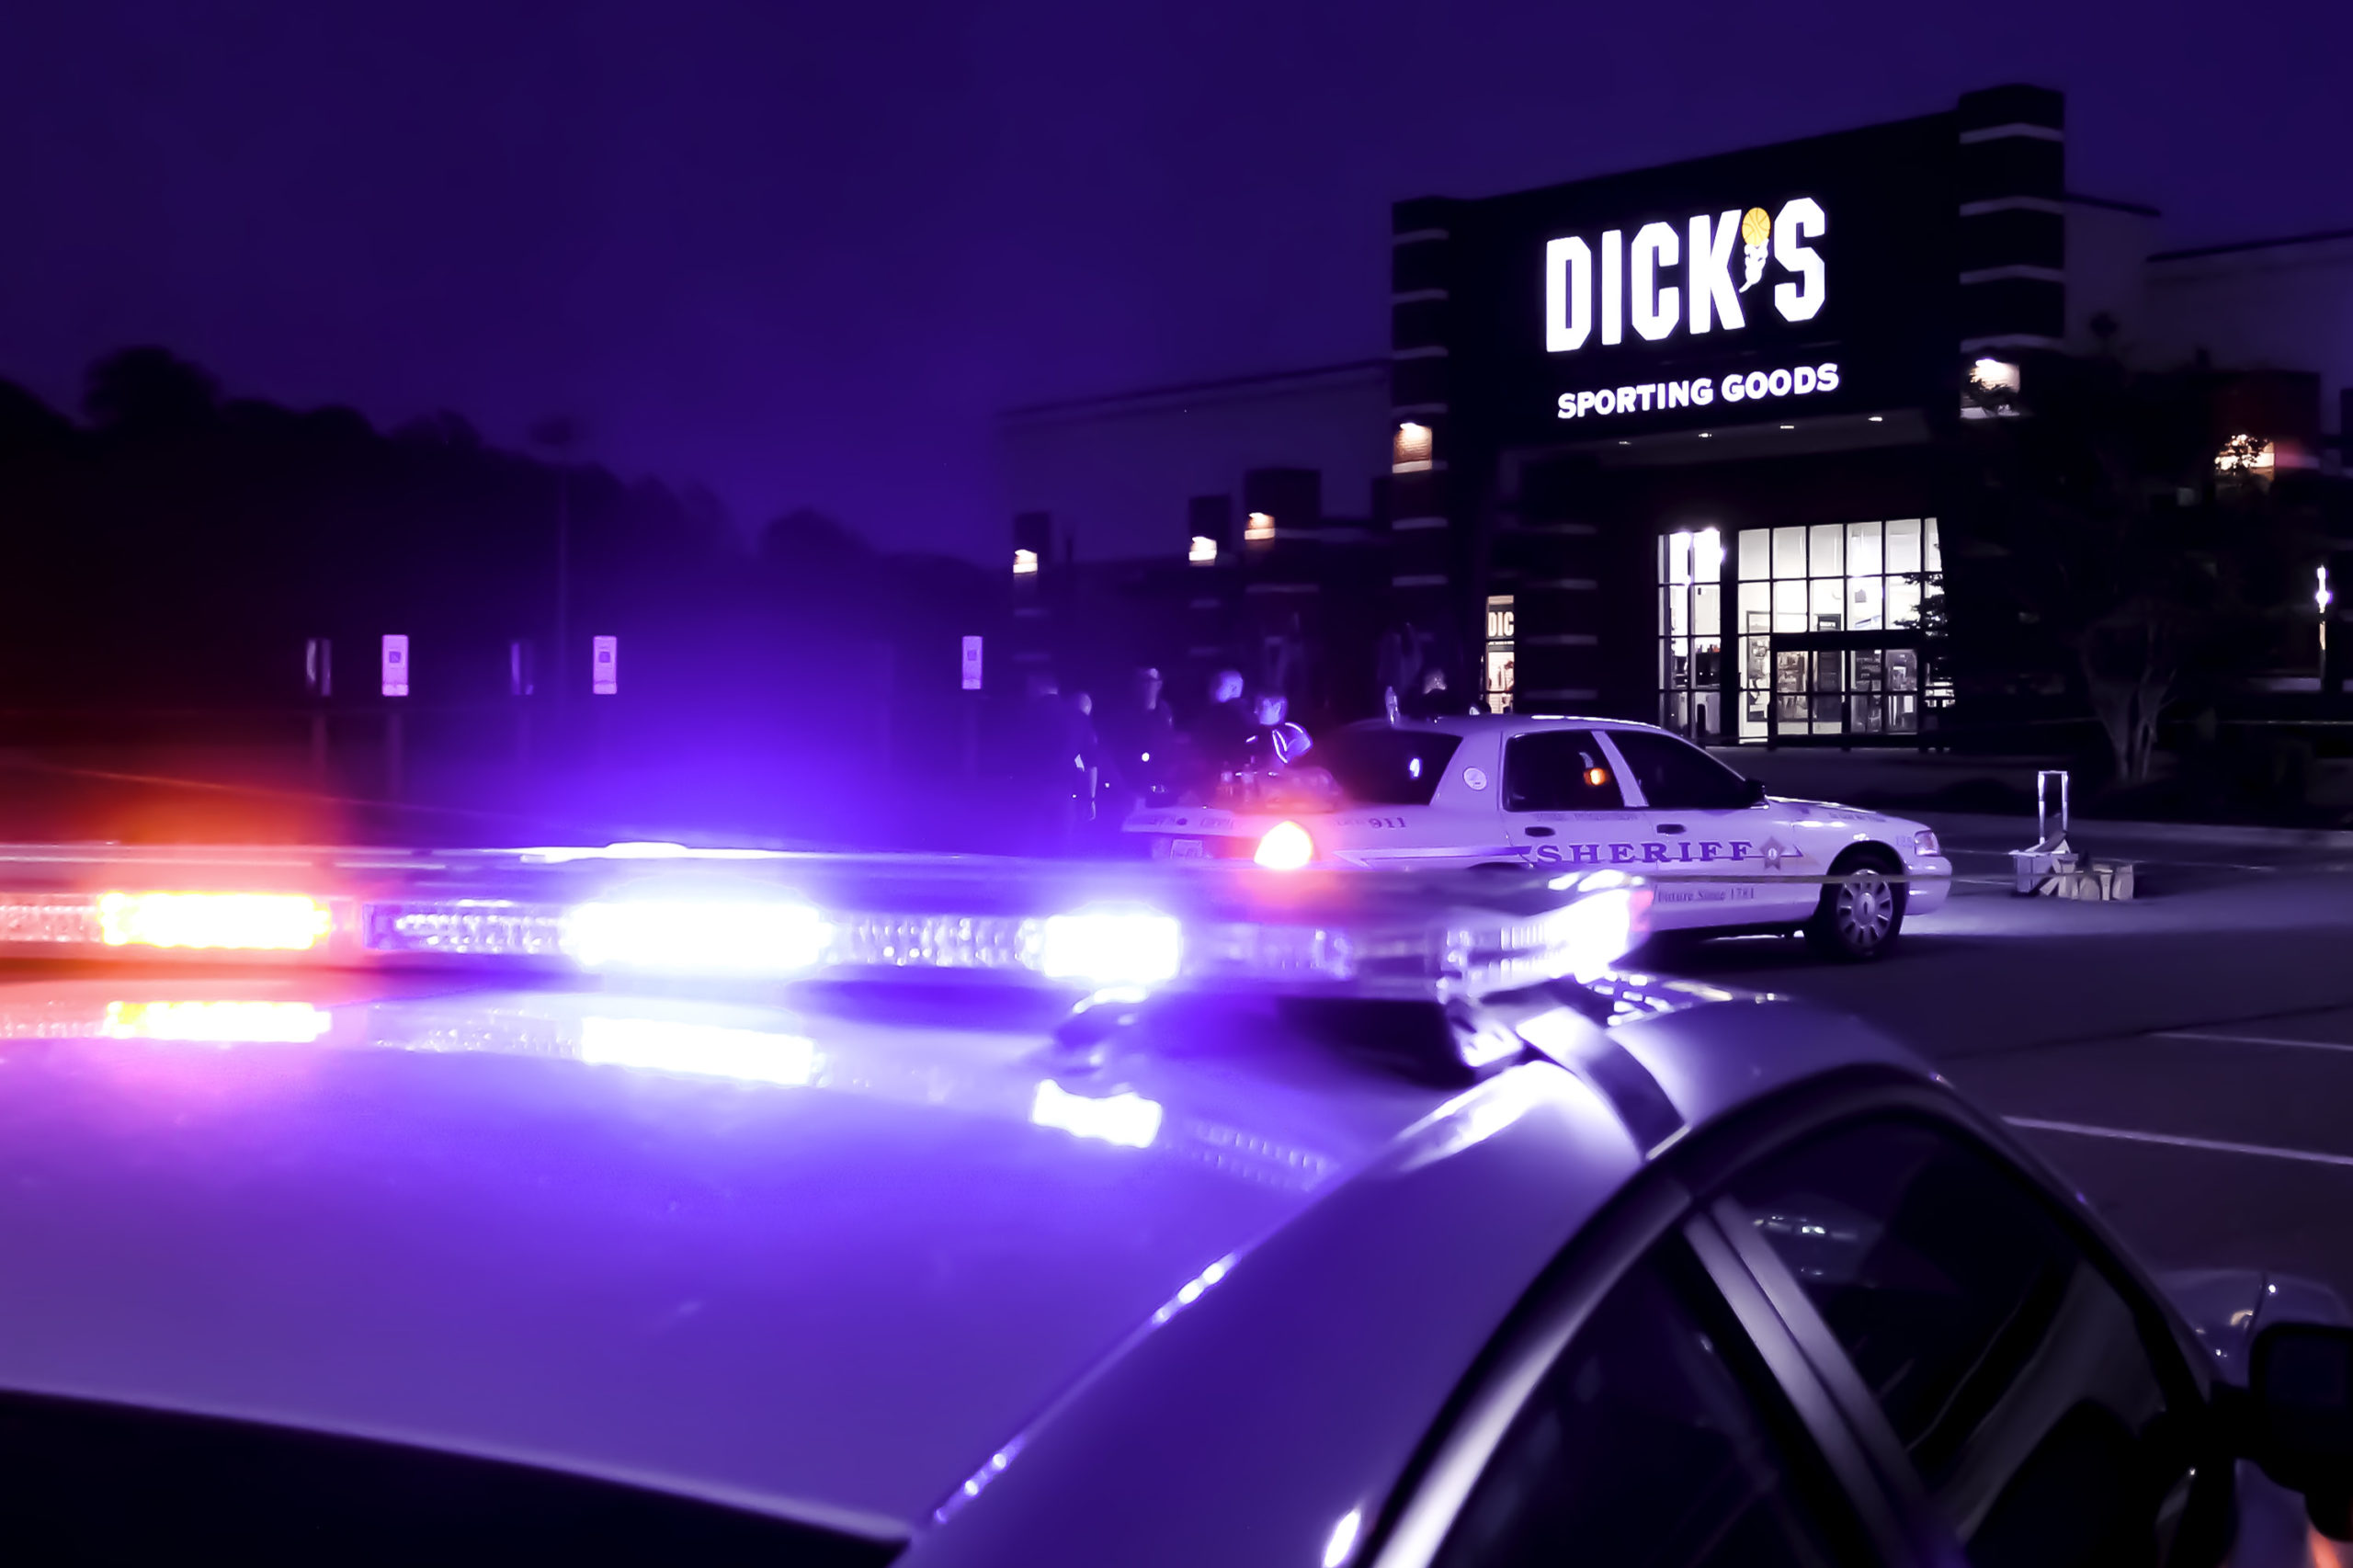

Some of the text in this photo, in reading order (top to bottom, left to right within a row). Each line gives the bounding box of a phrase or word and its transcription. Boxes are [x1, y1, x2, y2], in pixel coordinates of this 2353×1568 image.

[1546, 197, 1825, 353] DICK'S
[1557, 363, 1839, 419] SPORTING GOODS
[1368, 817, 1406, 828] 911
[1537, 841, 1753, 865] SHERIFF
